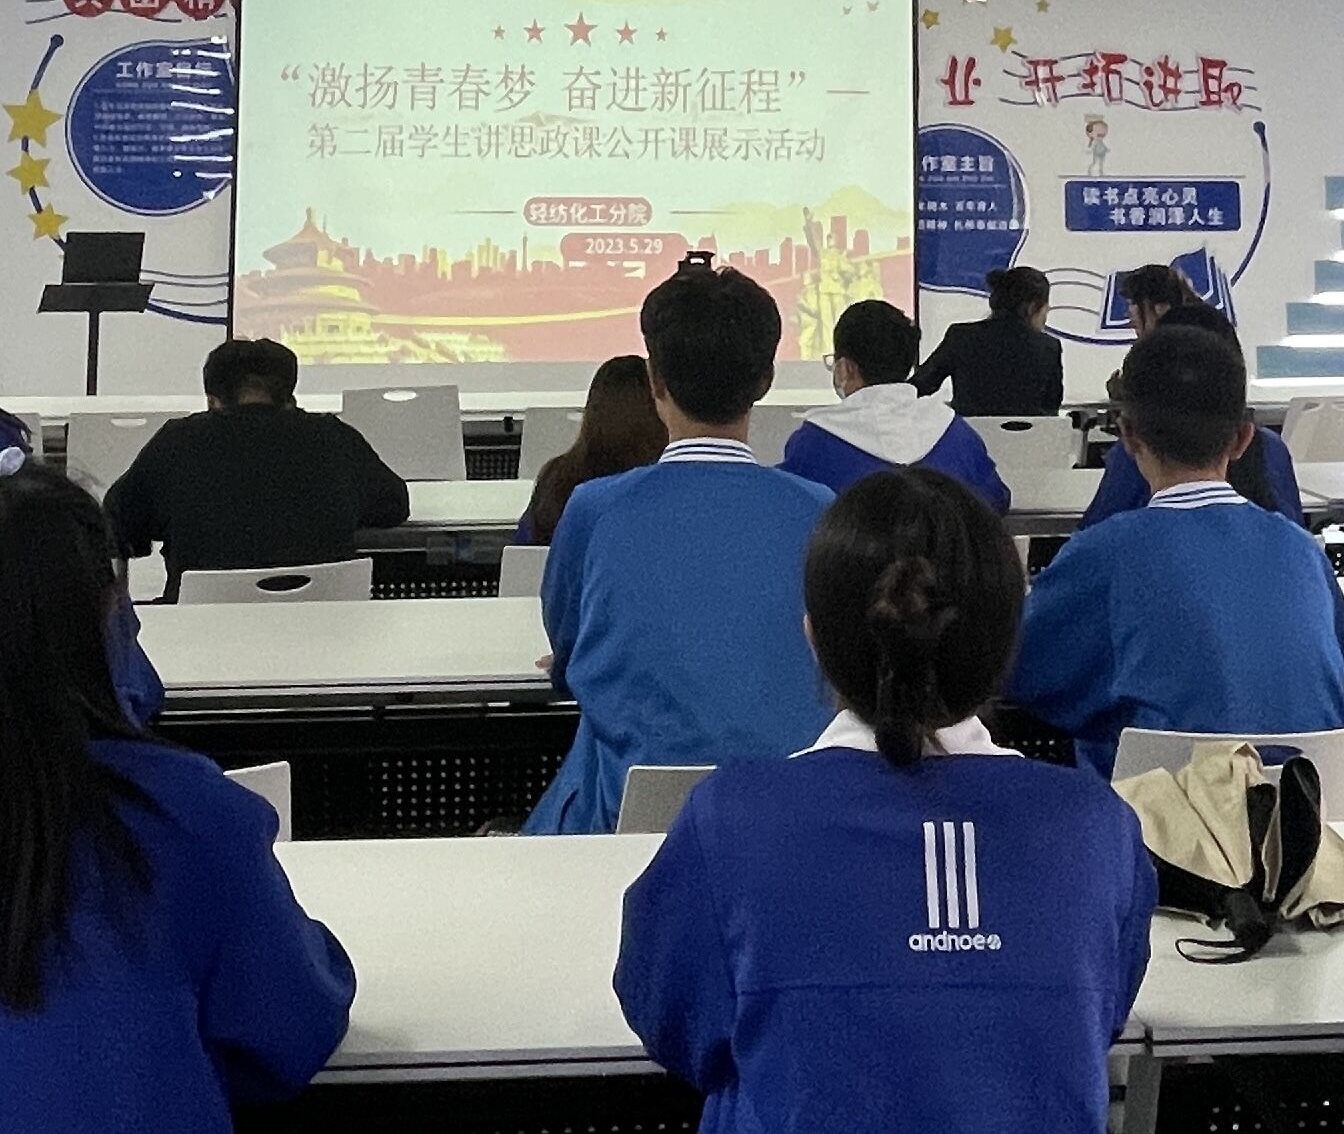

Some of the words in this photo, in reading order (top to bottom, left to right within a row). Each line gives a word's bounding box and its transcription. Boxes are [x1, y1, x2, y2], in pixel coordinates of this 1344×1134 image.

[307, 122, 826, 163] 第二届学生讲思政课公开课展示活动
[529, 201, 648, 224] 轻纺化工分院
[585, 238, 664, 254] 2023.5.29
